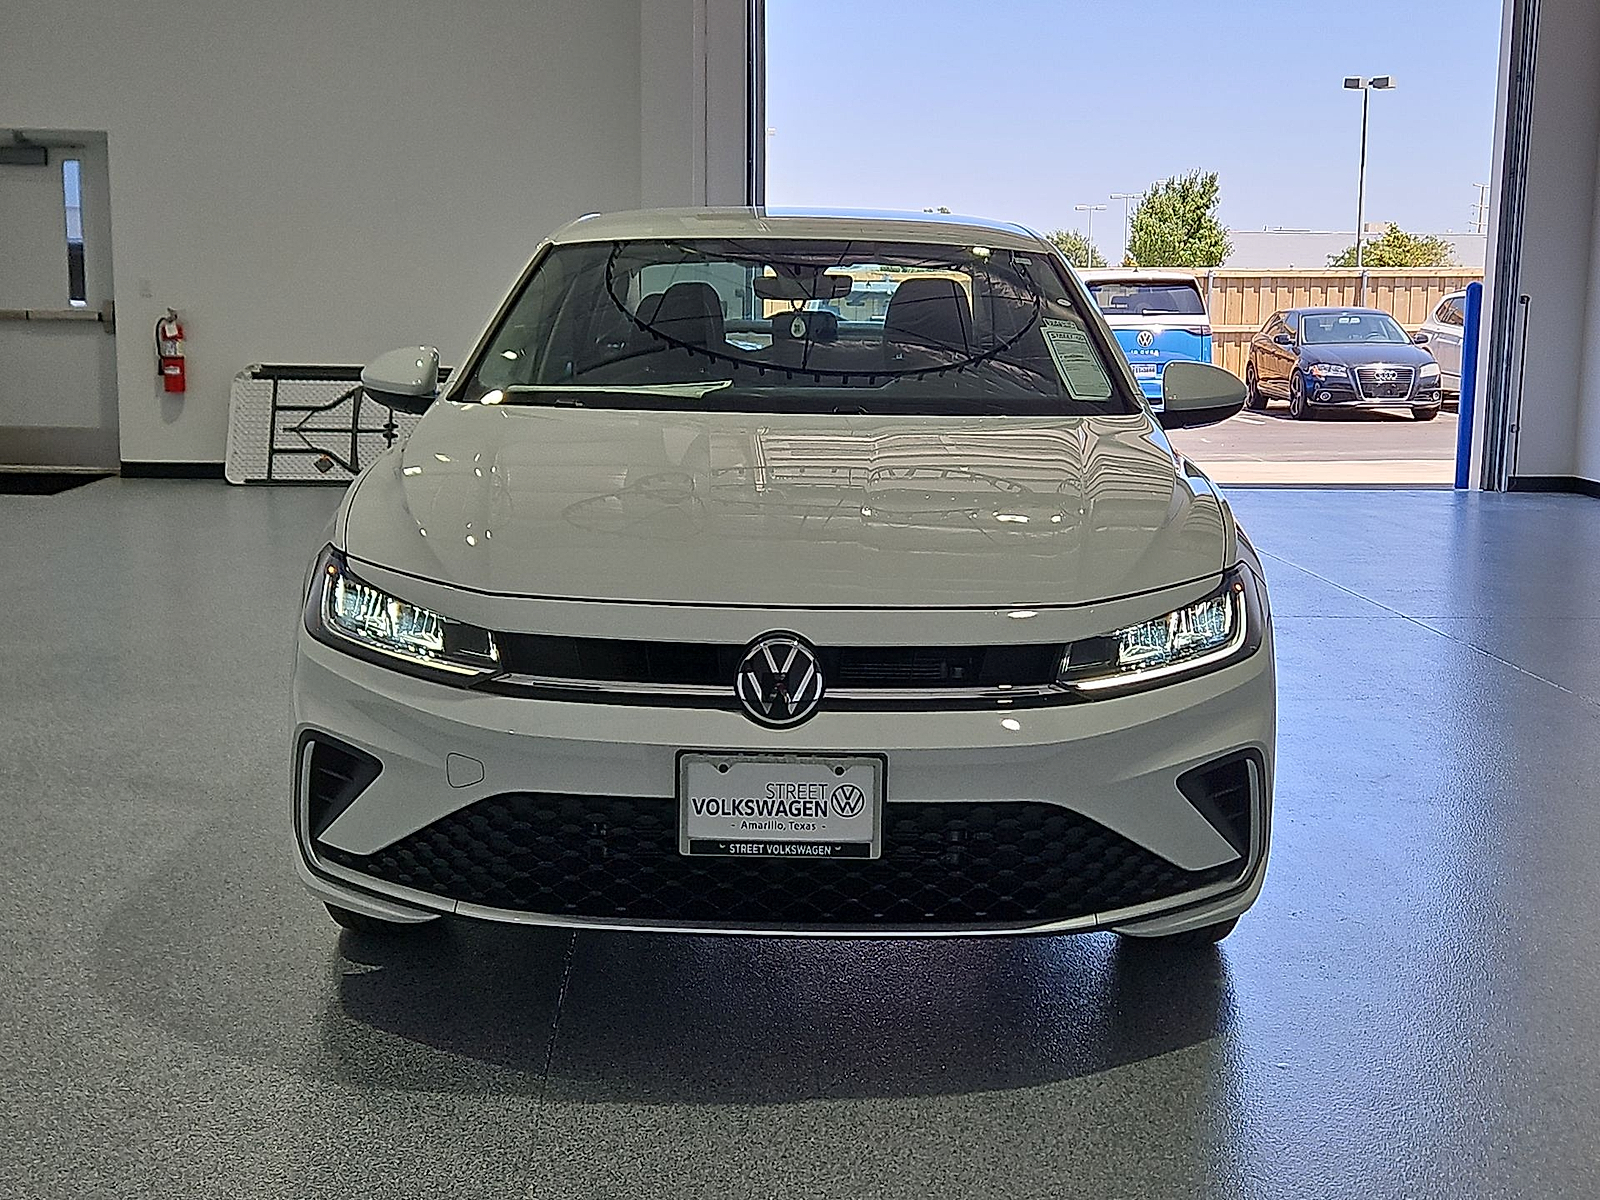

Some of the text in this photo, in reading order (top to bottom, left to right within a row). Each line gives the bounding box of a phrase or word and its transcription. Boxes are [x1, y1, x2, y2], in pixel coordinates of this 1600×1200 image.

[766, 783, 828, 800] STREET
[691, 798, 828, 817] VOLKSWAGEN
[740, 820, 817, 831] Amarillo, Texas
[729, 844, 832, 855] STREET VOLKSWAGEN
